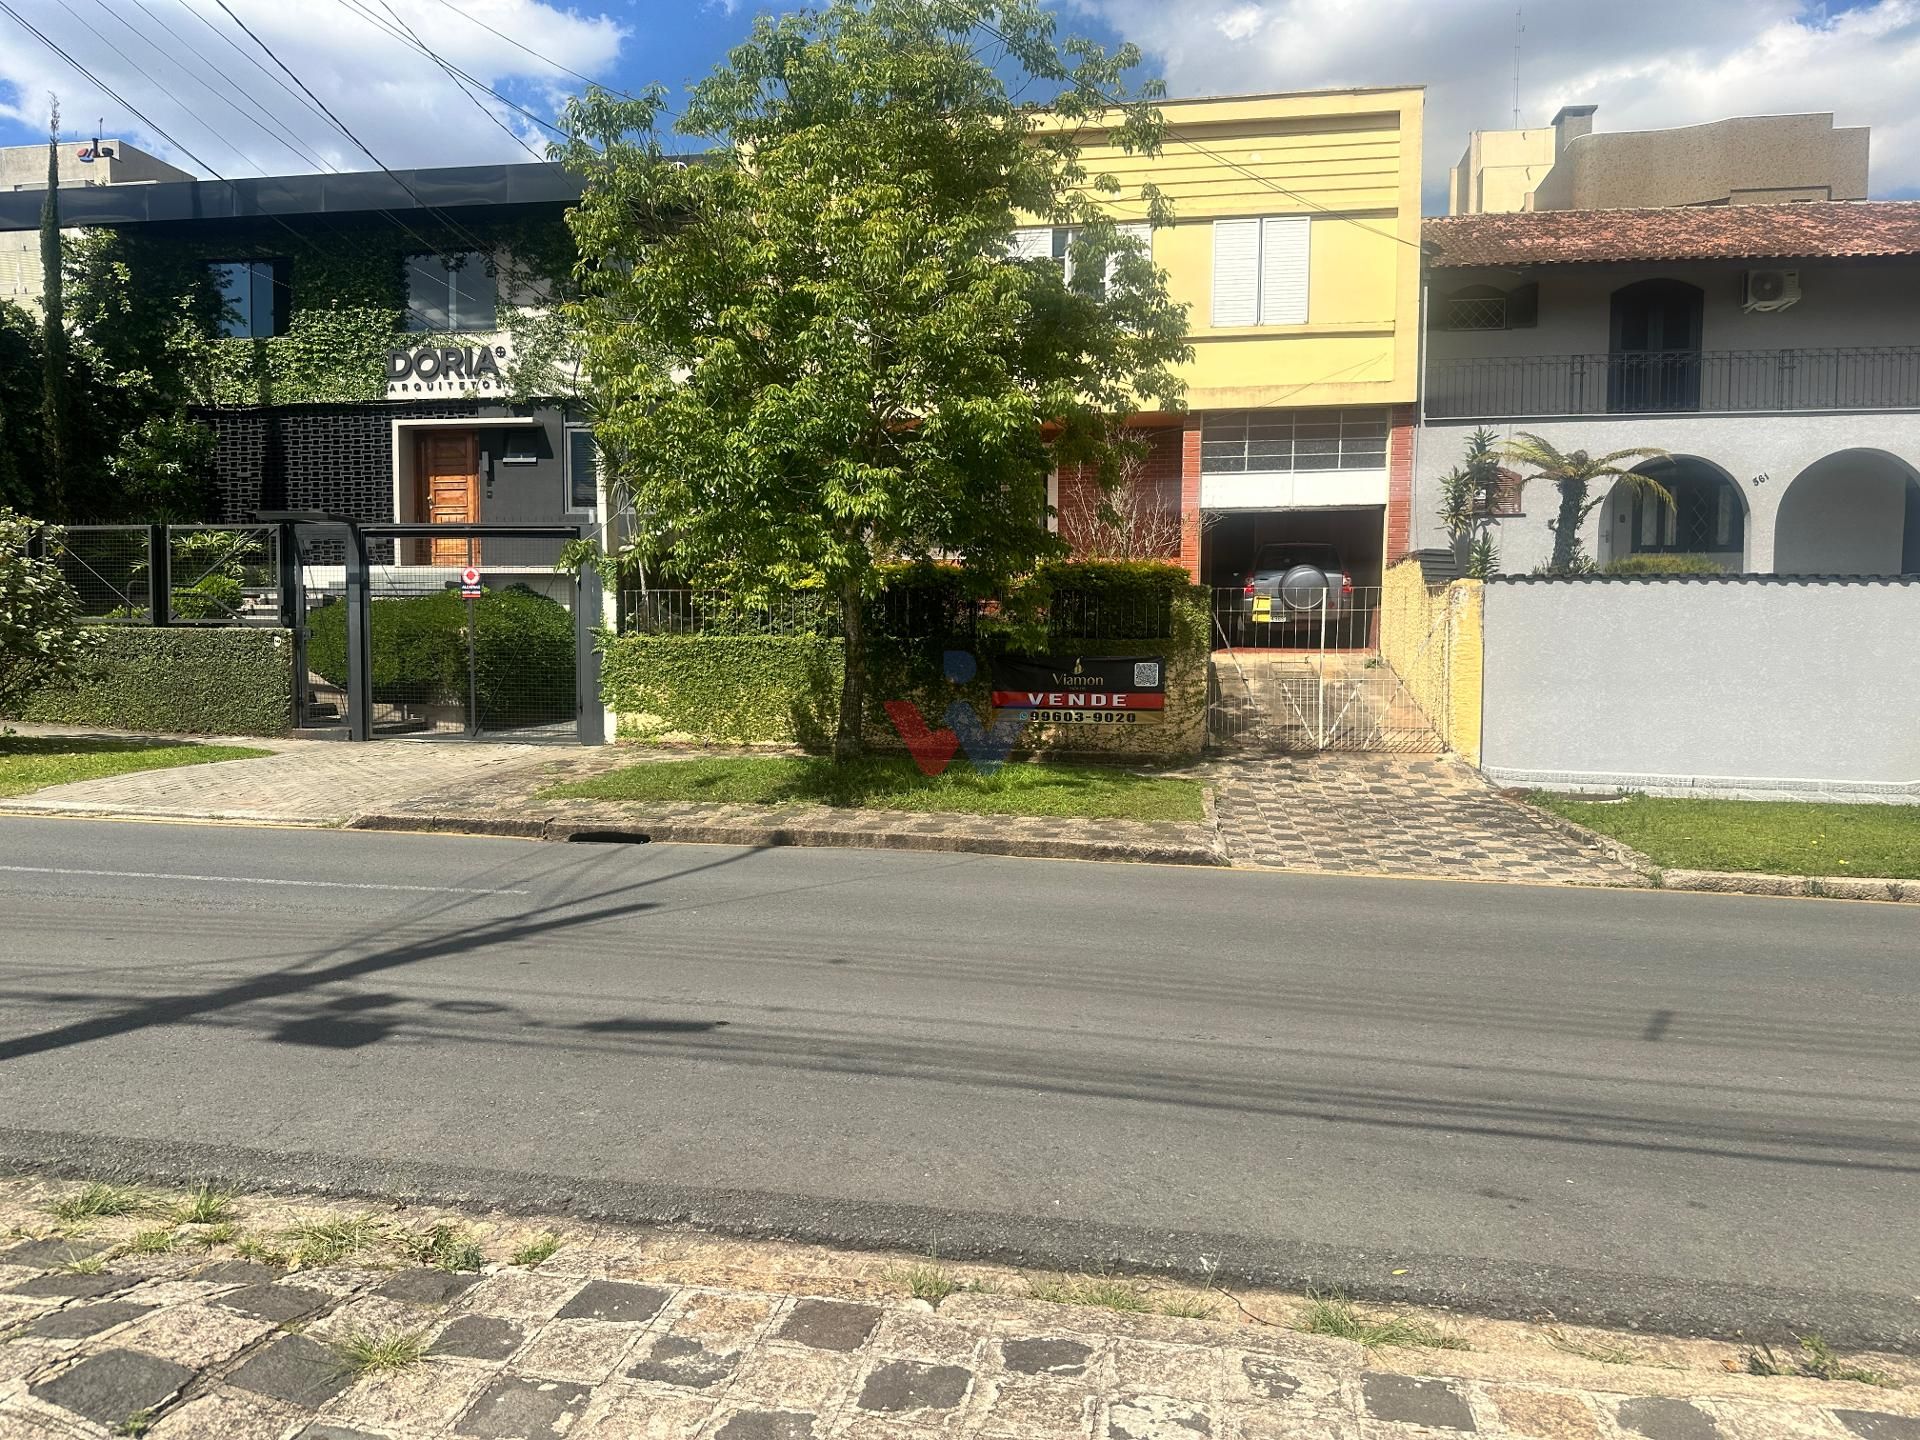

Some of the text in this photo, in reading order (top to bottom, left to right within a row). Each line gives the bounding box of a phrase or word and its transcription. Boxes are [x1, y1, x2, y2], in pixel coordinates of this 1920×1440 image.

[388, 346, 500, 382] DORIA
[389, 381, 502, 392] ARQUITETOS
[1752, 472, 1769, 486] 561
[1052, 673, 1104, 687] Viamon
[1028, 693, 1127, 707] VENDE
[1030, 711, 1136, 723] 99603-9020
